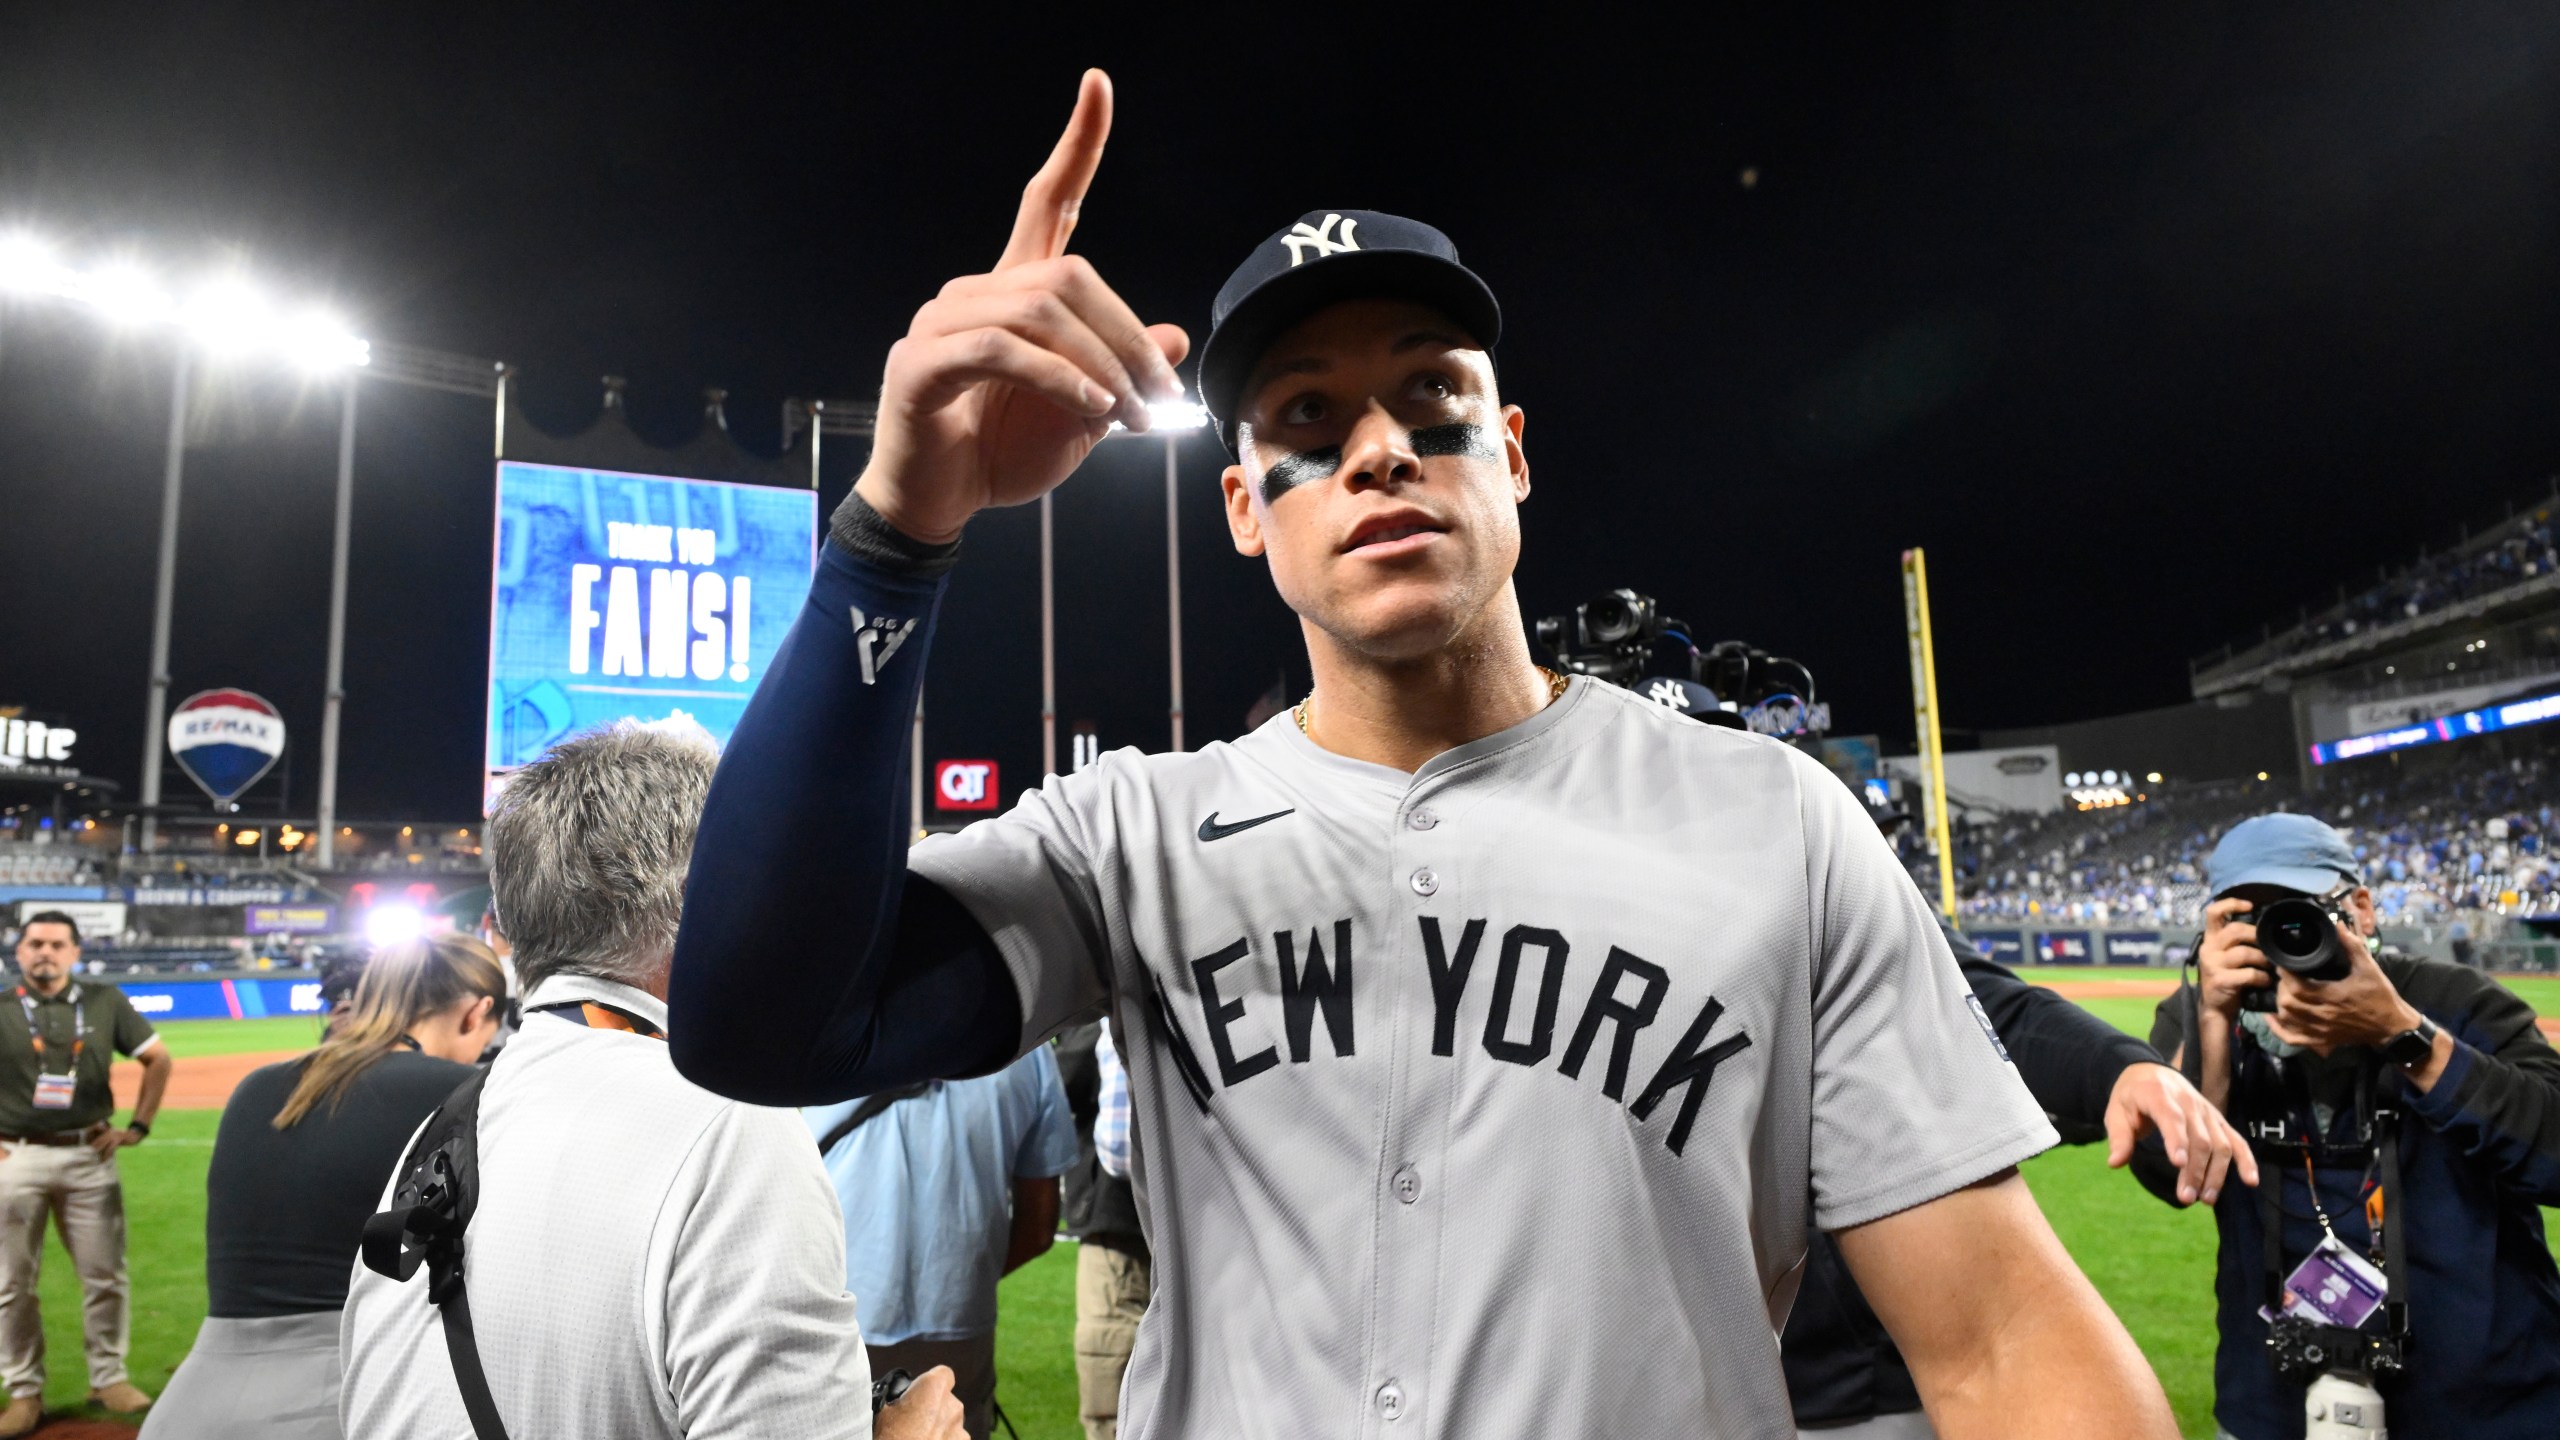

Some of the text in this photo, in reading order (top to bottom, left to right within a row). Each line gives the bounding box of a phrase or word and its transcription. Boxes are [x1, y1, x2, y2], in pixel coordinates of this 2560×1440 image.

[1280, 213, 1361, 268] NY
[608, 521, 716, 567] THANK YOU
[569, 563, 752, 683] FANS!
[941, 764, 990, 803] QT
[1418, 914, 1754, 1159] YORK
